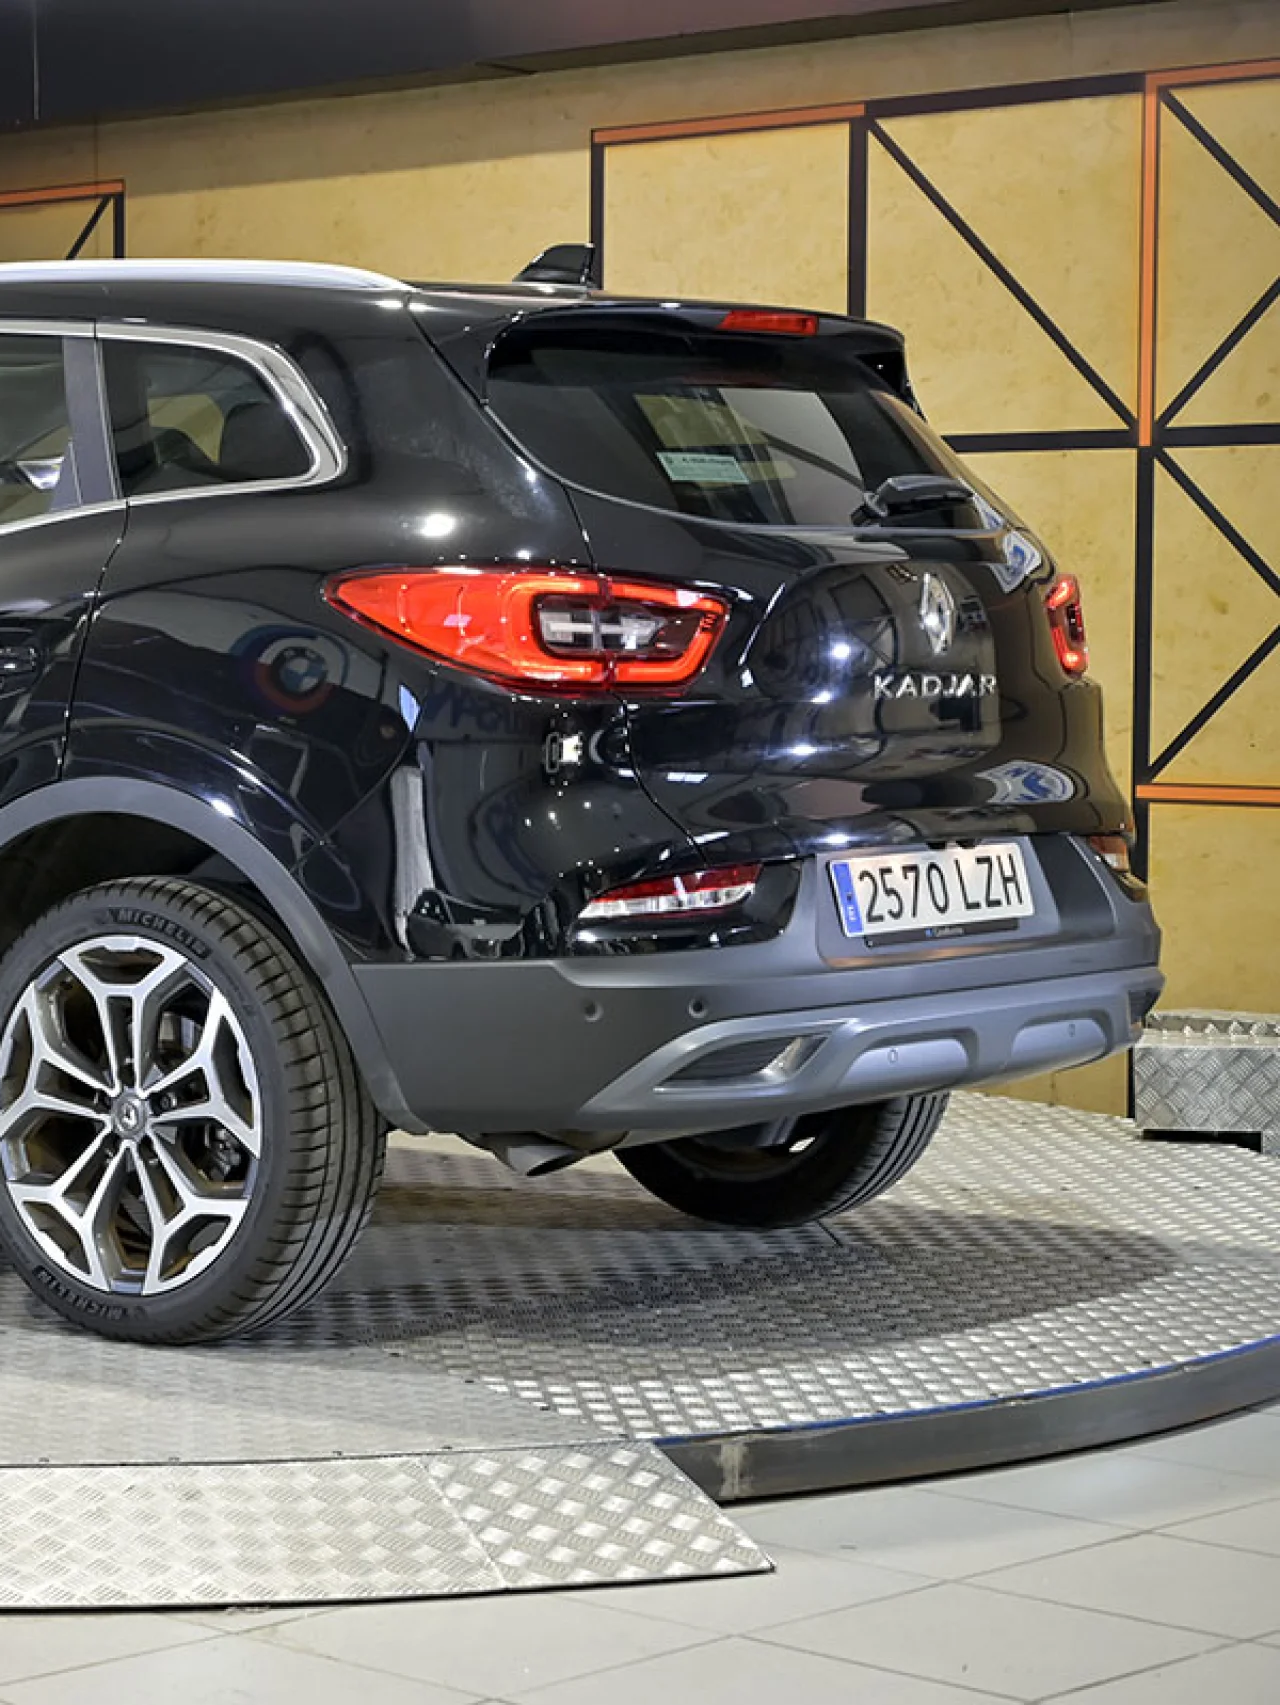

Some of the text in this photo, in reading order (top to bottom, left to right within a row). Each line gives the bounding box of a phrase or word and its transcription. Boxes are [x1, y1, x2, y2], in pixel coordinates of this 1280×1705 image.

[874, 674, 997, 699] KADJAR
[858, 862, 950, 923] 2570
[954, 853, 1023, 910] LZH
